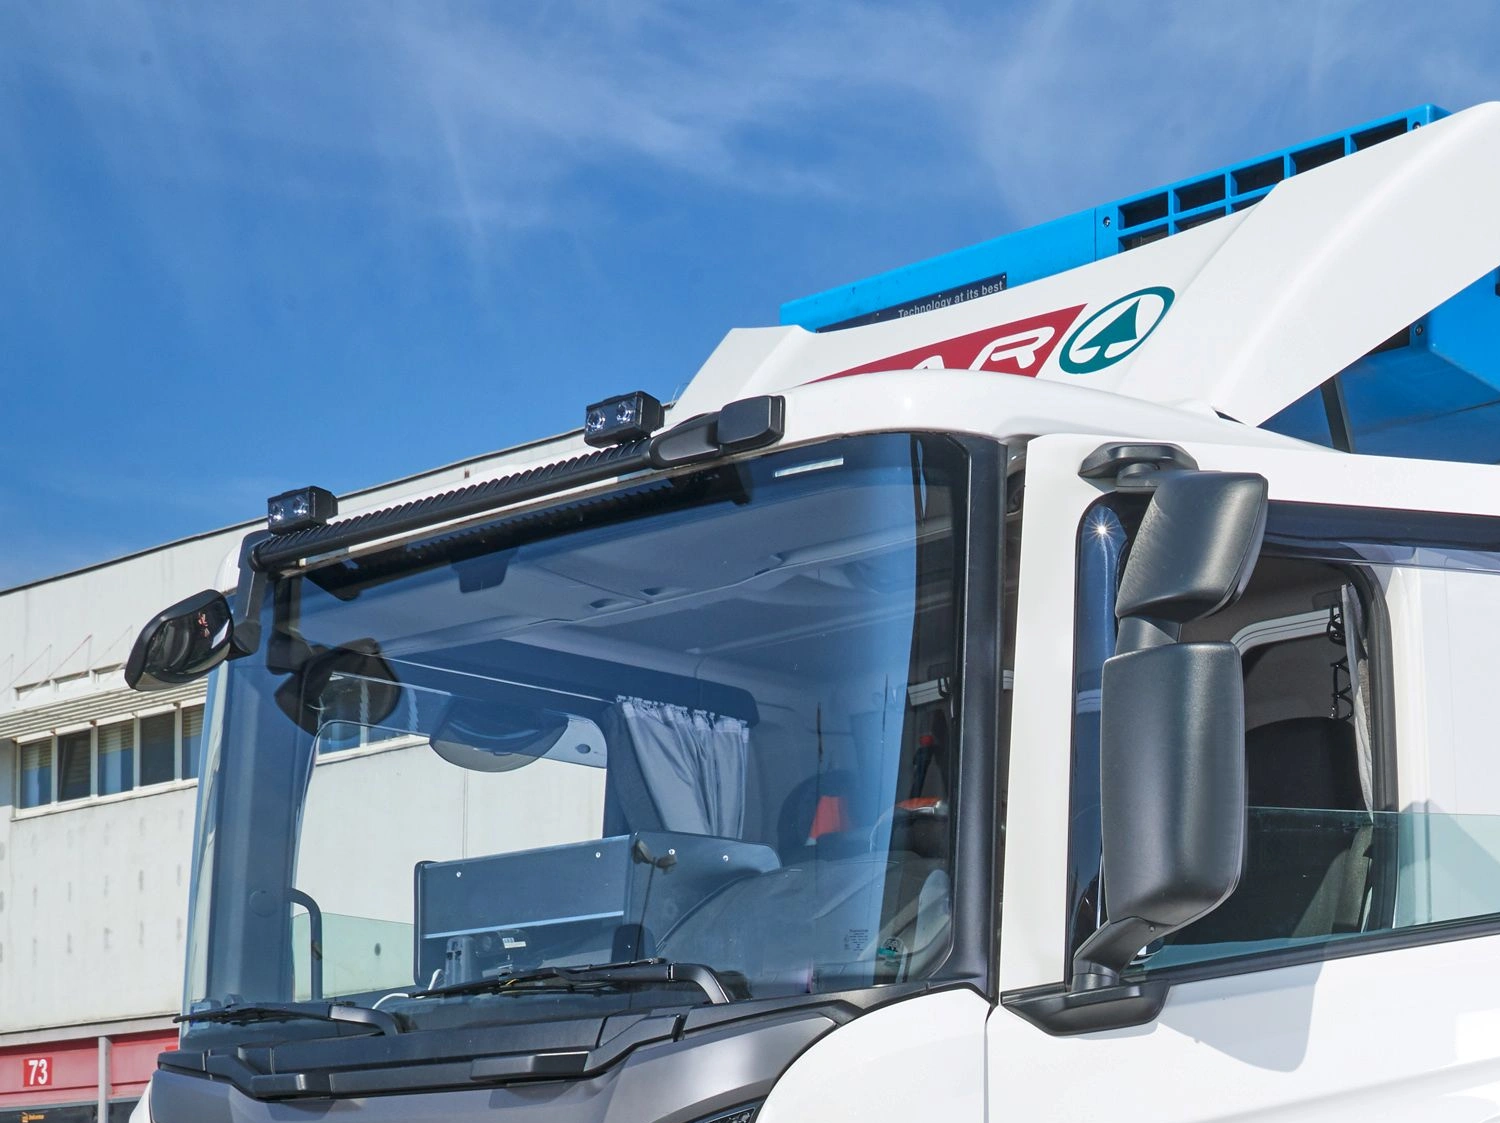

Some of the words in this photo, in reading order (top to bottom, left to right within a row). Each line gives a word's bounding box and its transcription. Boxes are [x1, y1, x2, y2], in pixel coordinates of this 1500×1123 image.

[898, 297, 952, 318] Technology
[954, 292, 964, 304] at
[966, 289, 979, 300] its
[981, 280, 1003, 295] best
[28, 1058, 48, 1085] 73
